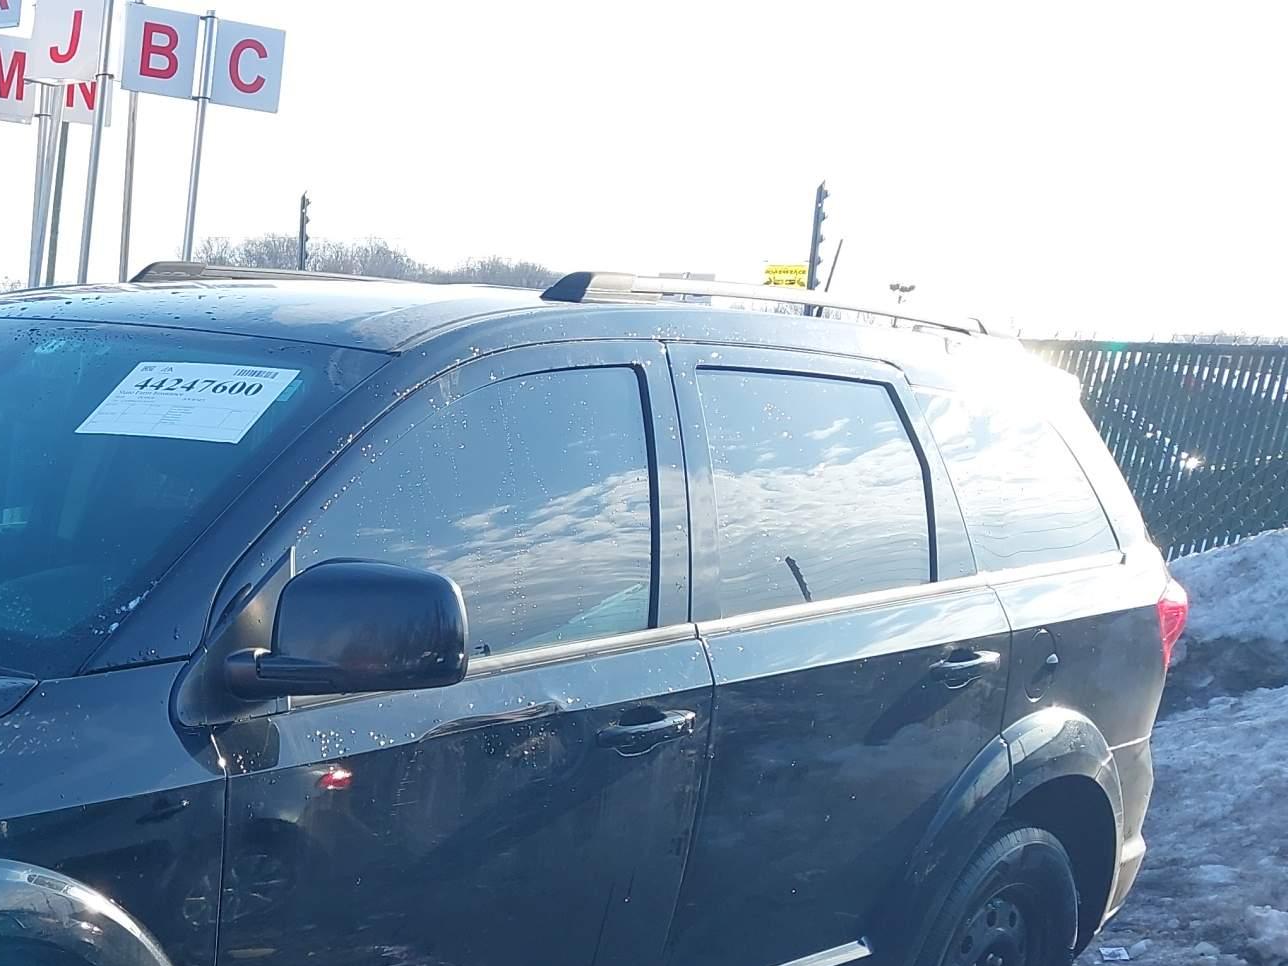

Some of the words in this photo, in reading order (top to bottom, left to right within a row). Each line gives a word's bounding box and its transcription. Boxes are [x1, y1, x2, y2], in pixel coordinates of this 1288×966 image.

[49, 10, 83, 64] J
[139, 21, 179, 80] B
[228, 38, 268, 94] C
[134, 377, 264, 397] 44247600
